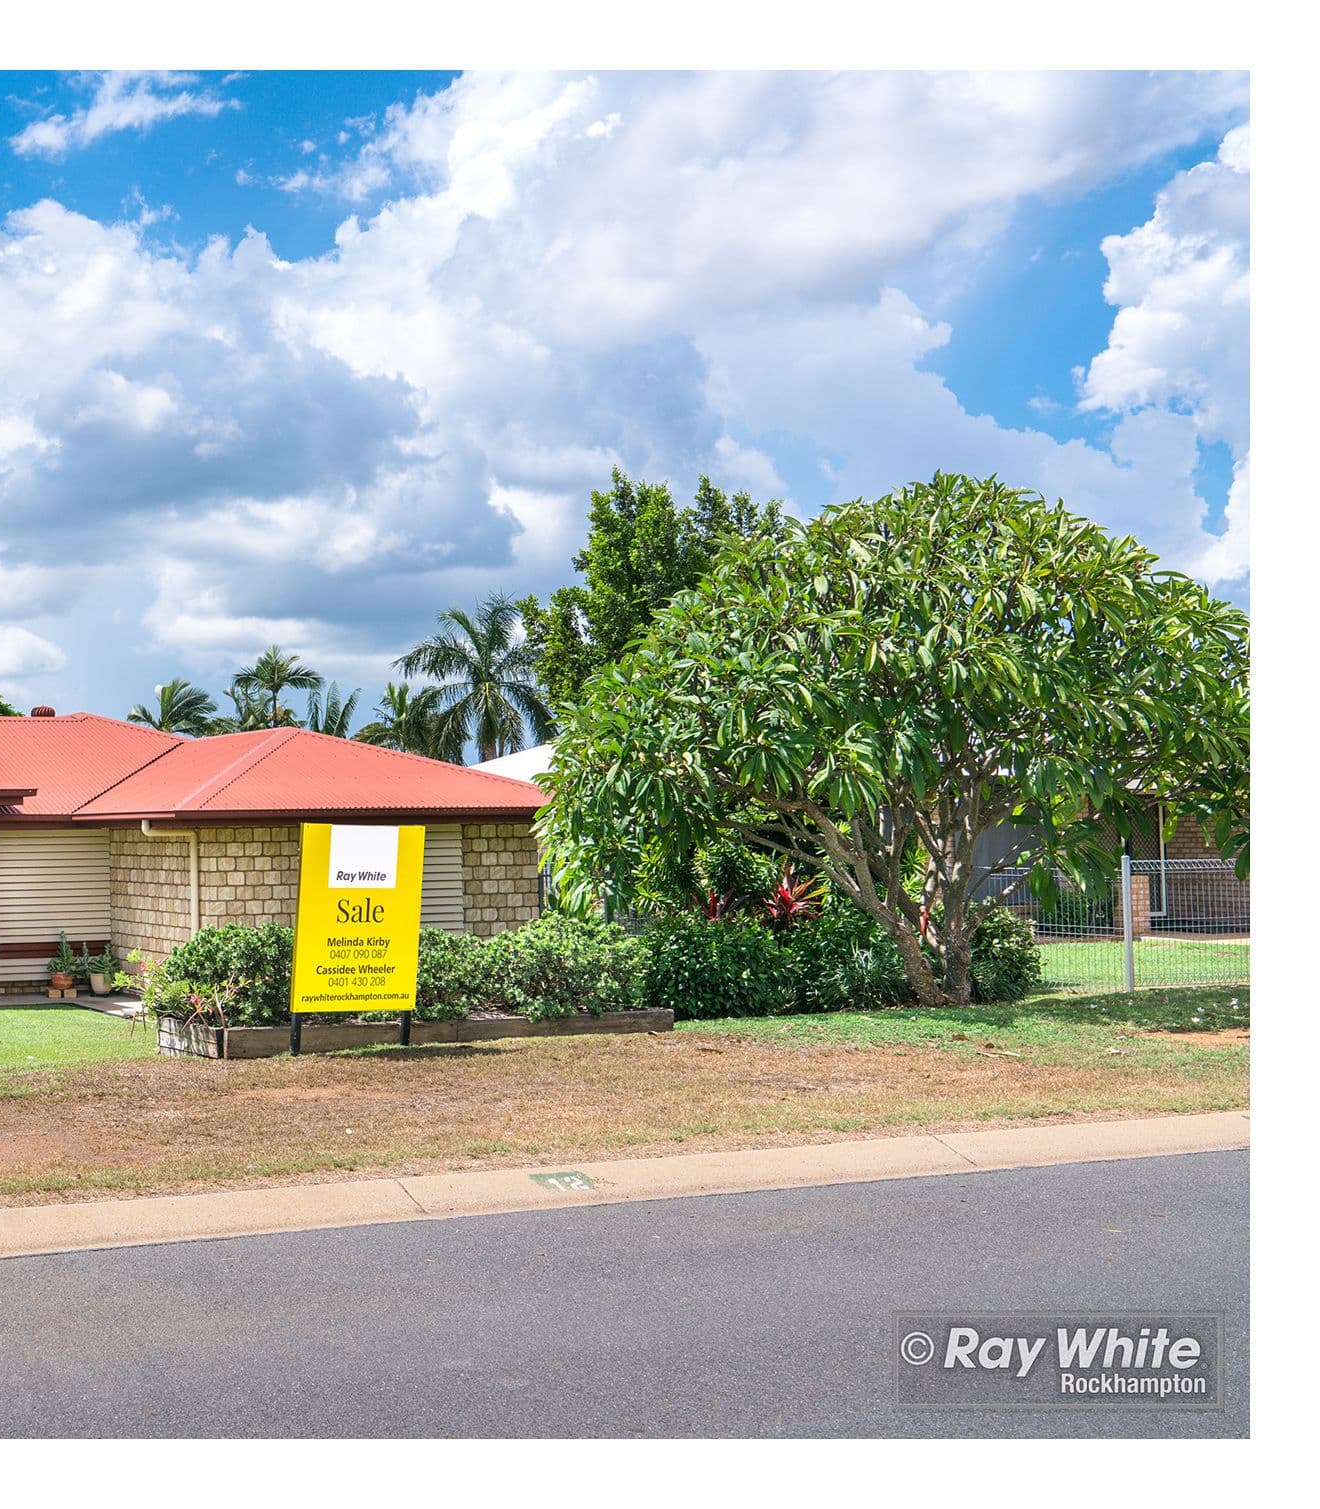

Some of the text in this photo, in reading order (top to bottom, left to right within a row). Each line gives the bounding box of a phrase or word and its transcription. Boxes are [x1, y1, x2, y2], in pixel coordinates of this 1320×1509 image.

[336, 871, 387, 883] Ray White
[336, 897, 385, 923] Sale
[327, 937, 391, 948] Melinda Kirby
[329, 949, 388, 960] 0407 090 087
[316, 964, 396, 975] Cassidee Wheeler
[328, 976, 386, 987] 0401 430 208
[301, 992, 410, 1003] raywhiterockhampton.com.au
[548, 1175, 590, 1192] 12
